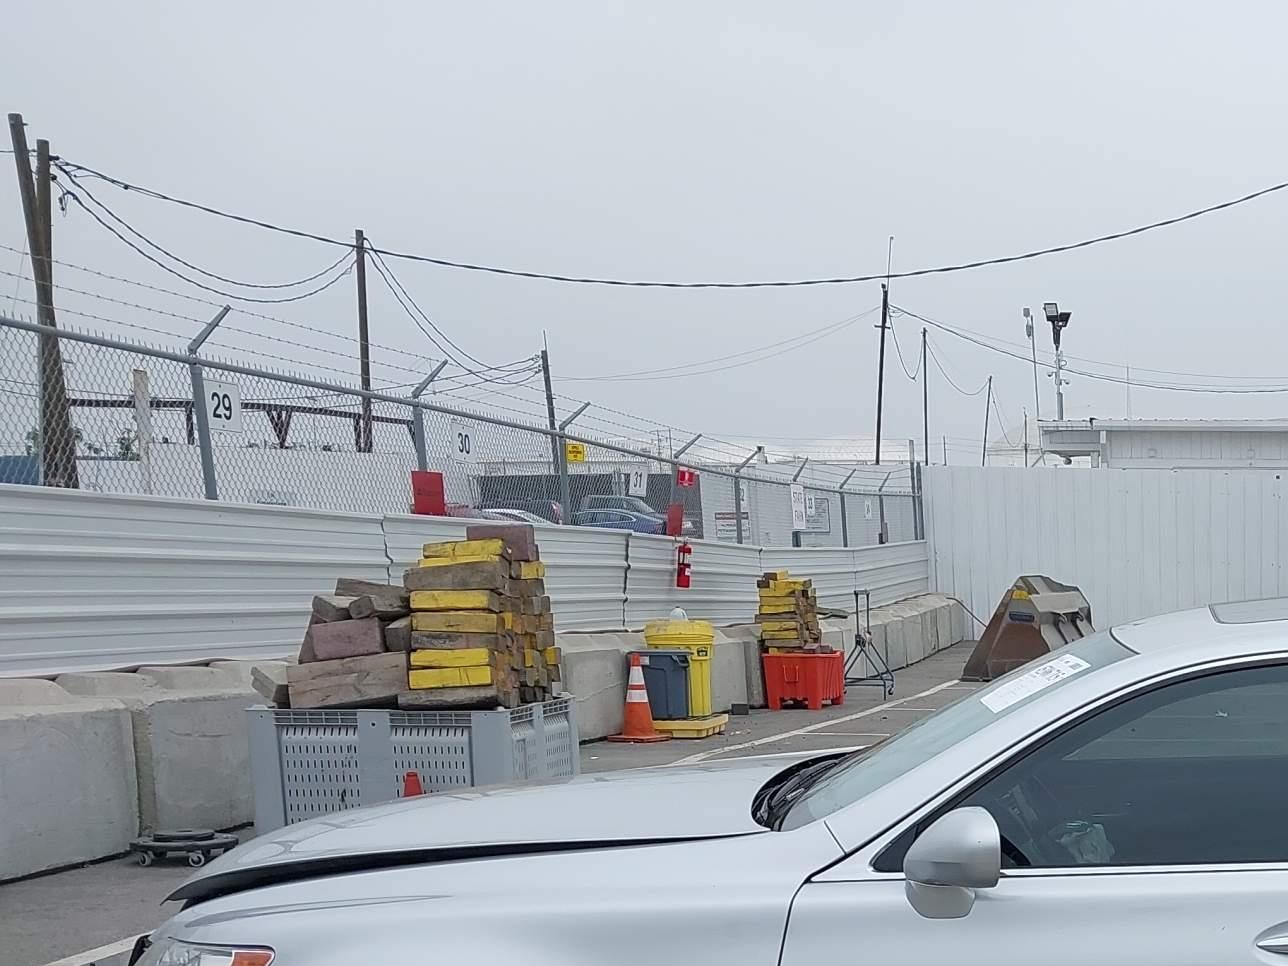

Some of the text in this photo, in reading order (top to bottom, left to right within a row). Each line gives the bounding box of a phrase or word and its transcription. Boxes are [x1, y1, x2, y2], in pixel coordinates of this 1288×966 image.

[211, 391, 233, 421] 29
[457, 432, 471, 455] 30
[633, 471, 644, 490] 31
